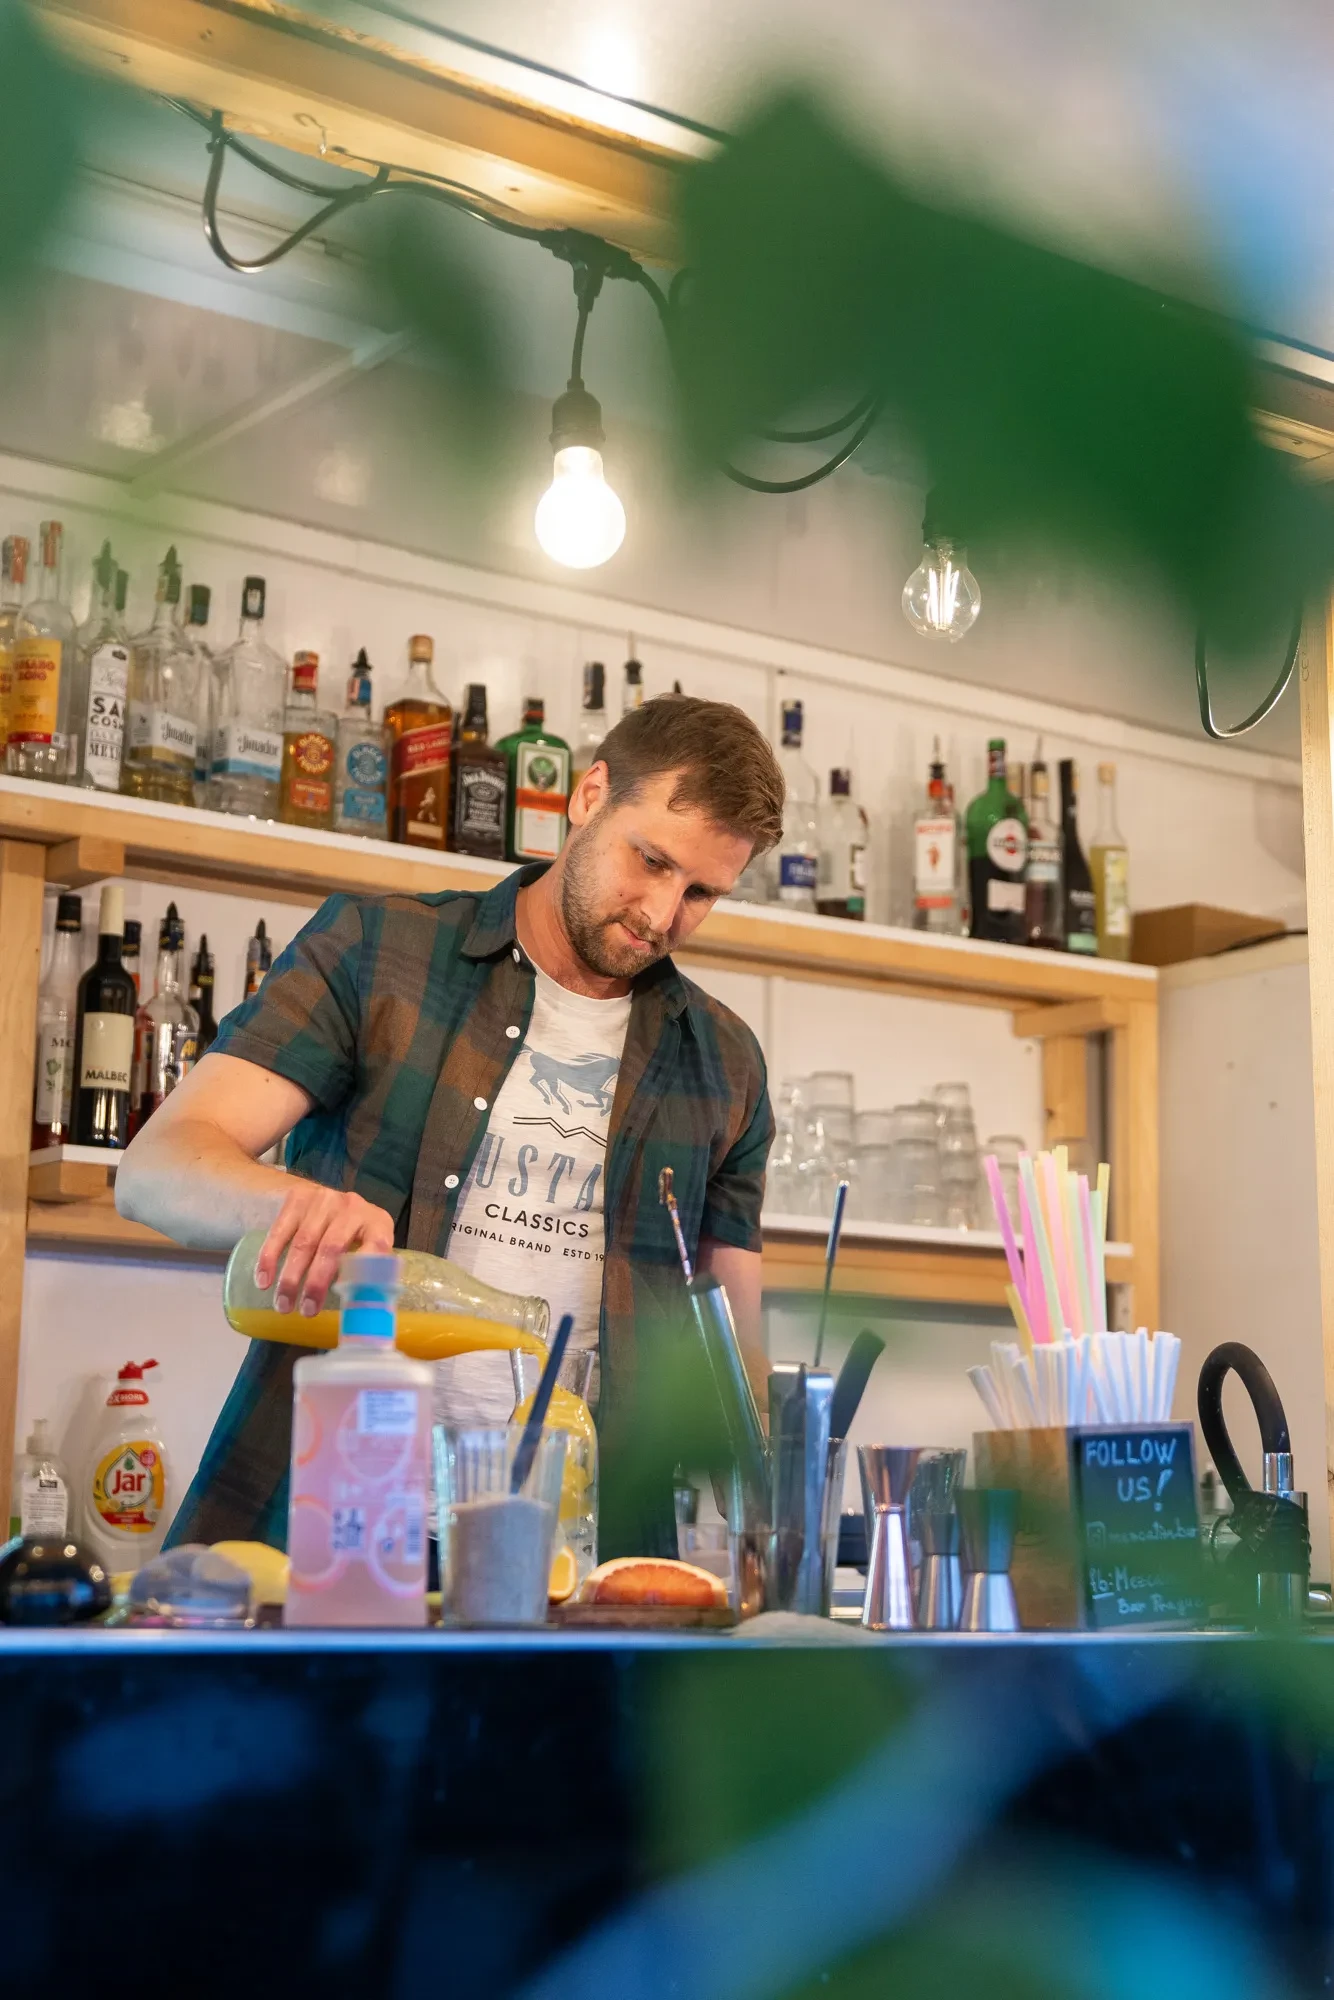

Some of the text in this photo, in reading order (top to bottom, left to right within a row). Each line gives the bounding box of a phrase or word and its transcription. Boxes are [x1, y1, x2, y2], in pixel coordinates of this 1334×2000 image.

[92, 696, 120, 718] SA
[85, 1069, 128, 1082] MALBEC
[475, 1131, 603, 1212] USTA
[484, 1203, 589, 1238] CLASSICS
[451, 1222, 605, 1262] RIGINAL BRAND ESTD 19
[1086, 1438, 1177, 1467] FOLLOW
[111, 1469, 146, 1495] Jar
[1117, 1468, 1174, 1513] US!
